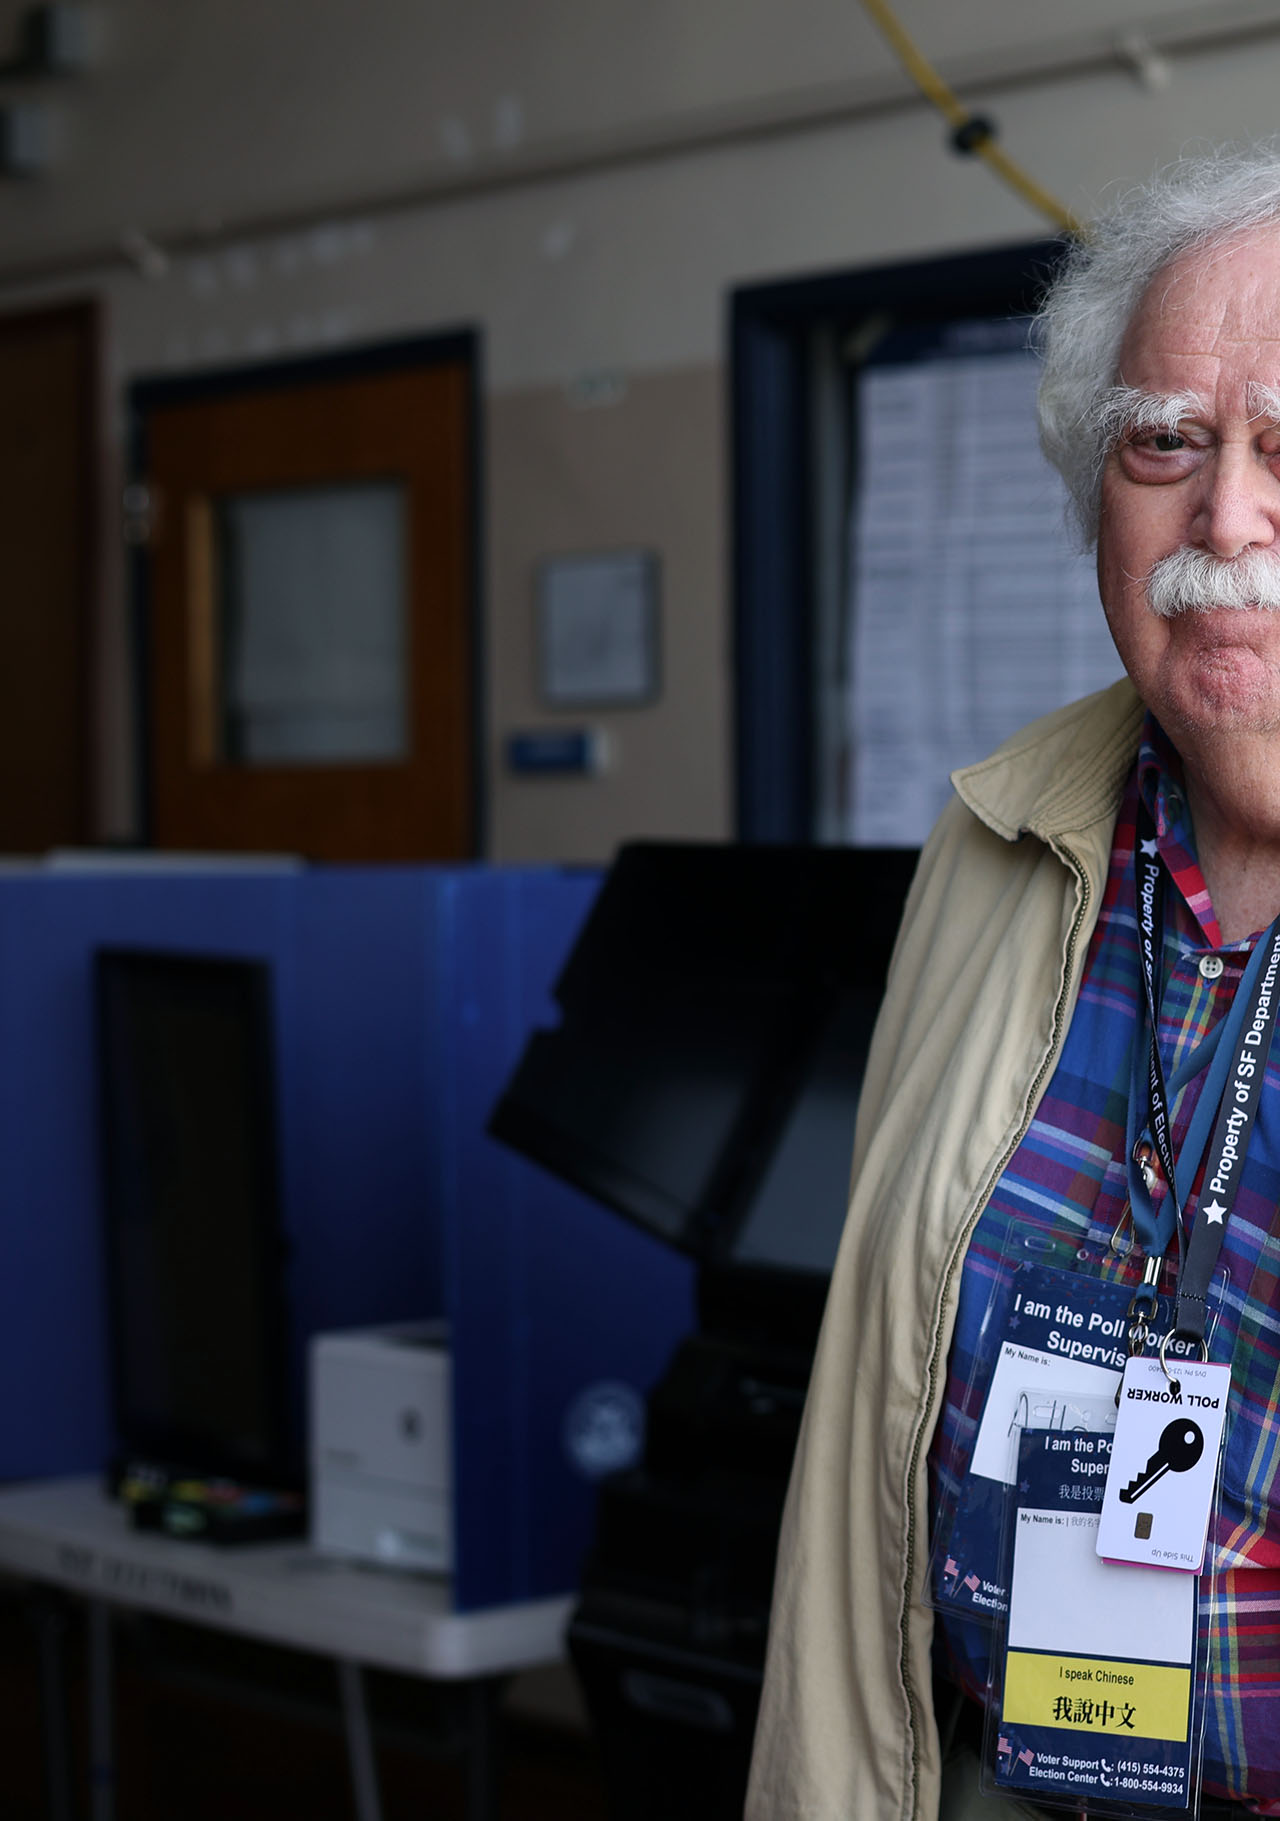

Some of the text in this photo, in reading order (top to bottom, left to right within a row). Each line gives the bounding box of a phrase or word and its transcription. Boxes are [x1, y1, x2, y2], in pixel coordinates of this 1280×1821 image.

[1140, 863, 1160, 937] Property
[1144, 939, 1154, 961] of
[1237, 1049, 1257, 1078] SF
[1152, 1092, 1162, 1111] of
[1234, 1079, 1251, 1103] of
[1154, 1114, 1176, 1189] Electio
[1209, 1106, 1249, 1194] Property
[1014, 1293, 1022, 1312] I
[1023, 1300, 1051, 1320] am
[1055, 1304, 1084, 1328] the
[1087, 1312, 1126, 1338] Poll
[1004, 1347, 1051, 1366] My Name is:
[1046, 1330, 1127, 1367] Supervis
[1127, 1387, 1220, 1409] POLL WORKER
[1044, 1435, 1113, 1454] I am the Po
[1071, 1458, 1110, 1477] Super
[1059, 1484, 1105, 1501] 我是投票
[1020, 1513, 1031, 1524] My
[1033, 1515, 1053, 1524] Name
[1055, 1516, 1065, 1525] is:
[1151, 1549, 1194, 1563] This Side Up
[972, 1592, 1008, 1612] Election
[1059, 1666, 1135, 1686] I speak Chinese
[1052, 1695, 1137, 1729] 我說中文
[1029, 1766, 1065, 1780] Election
[1067, 1770, 1099, 1784] Center
[1036, 1752, 1061, 1764] Voter
[1062, 1755, 1100, 1770] Support
[1117, 1760, 1141, 1775] (415)
[1142, 1763, 1185, 1778] 554-4375
